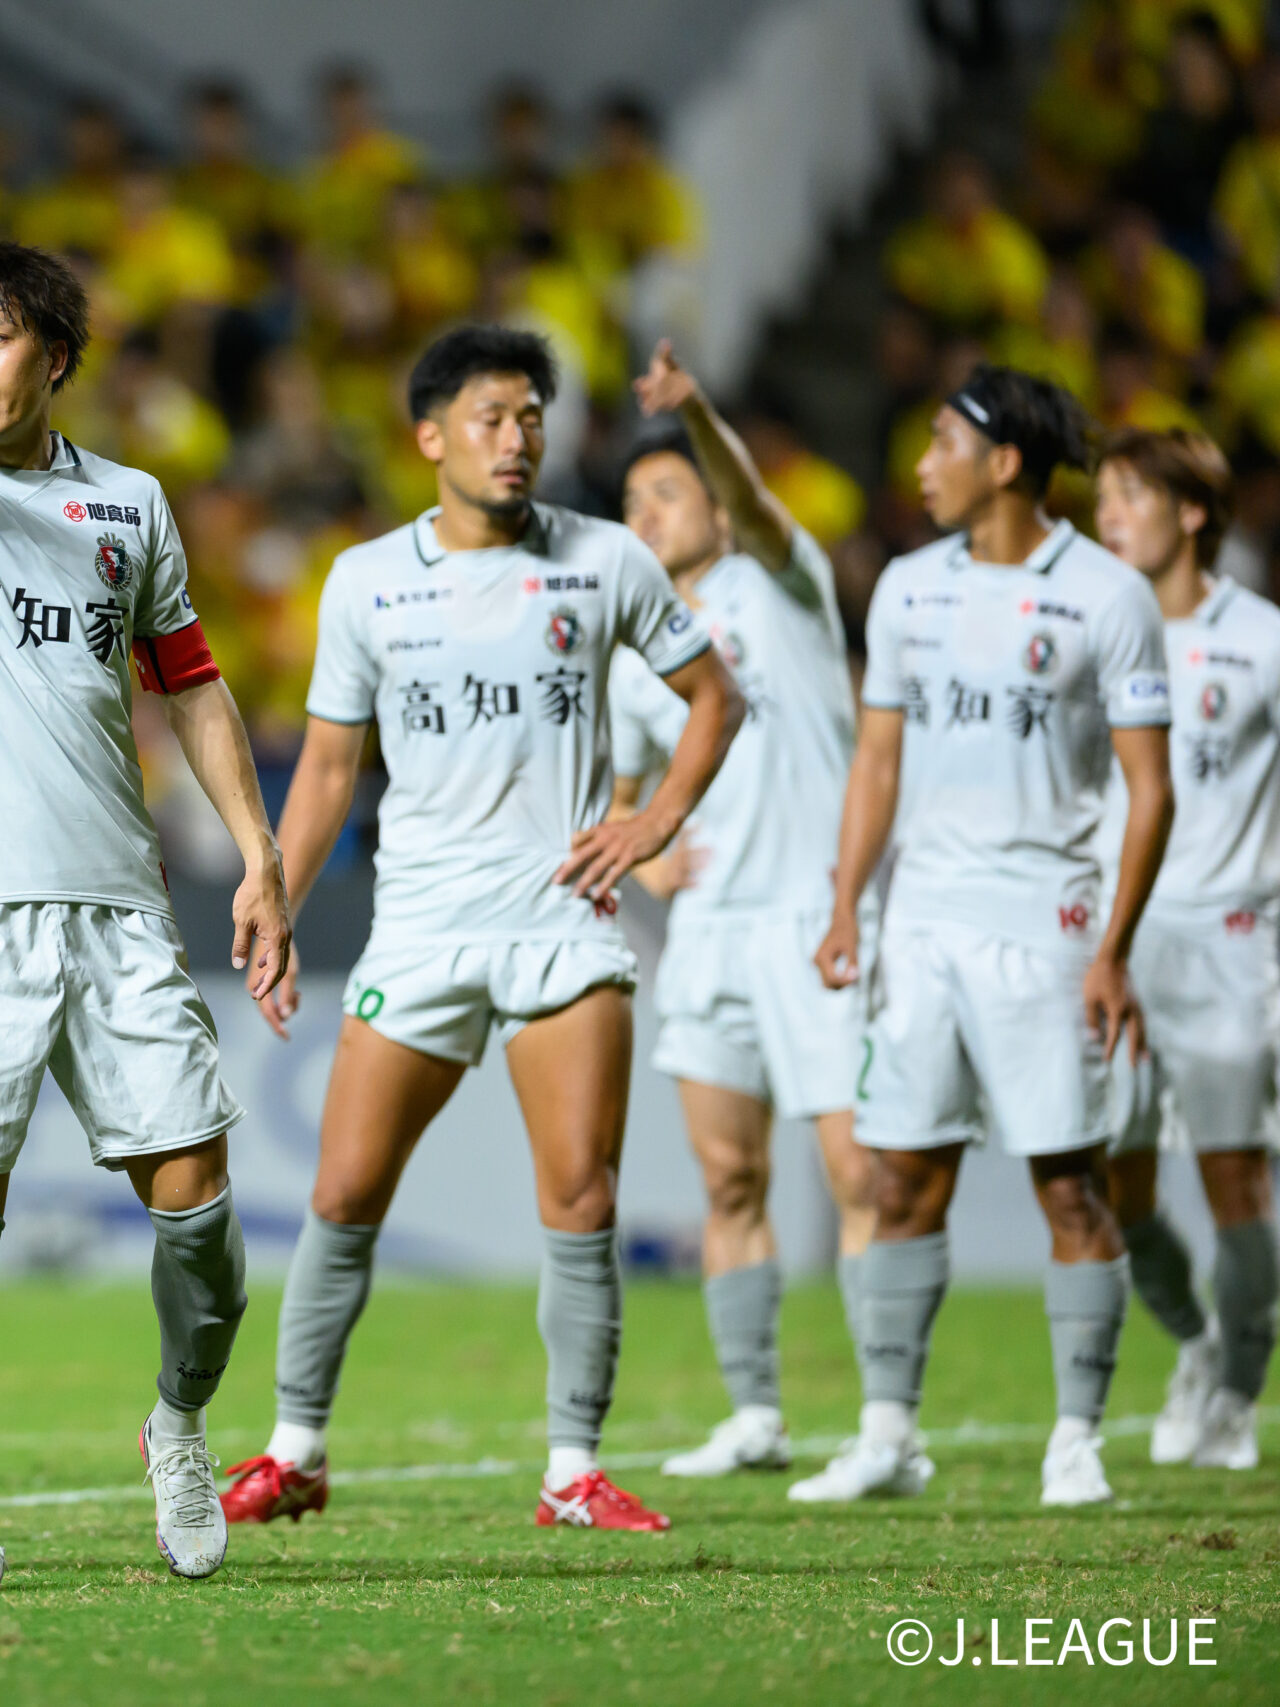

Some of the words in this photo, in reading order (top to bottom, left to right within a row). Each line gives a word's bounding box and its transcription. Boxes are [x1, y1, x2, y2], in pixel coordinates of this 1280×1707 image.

[86, 503, 141, 527] 旭食品
[397, 666, 589, 735] 高知家
